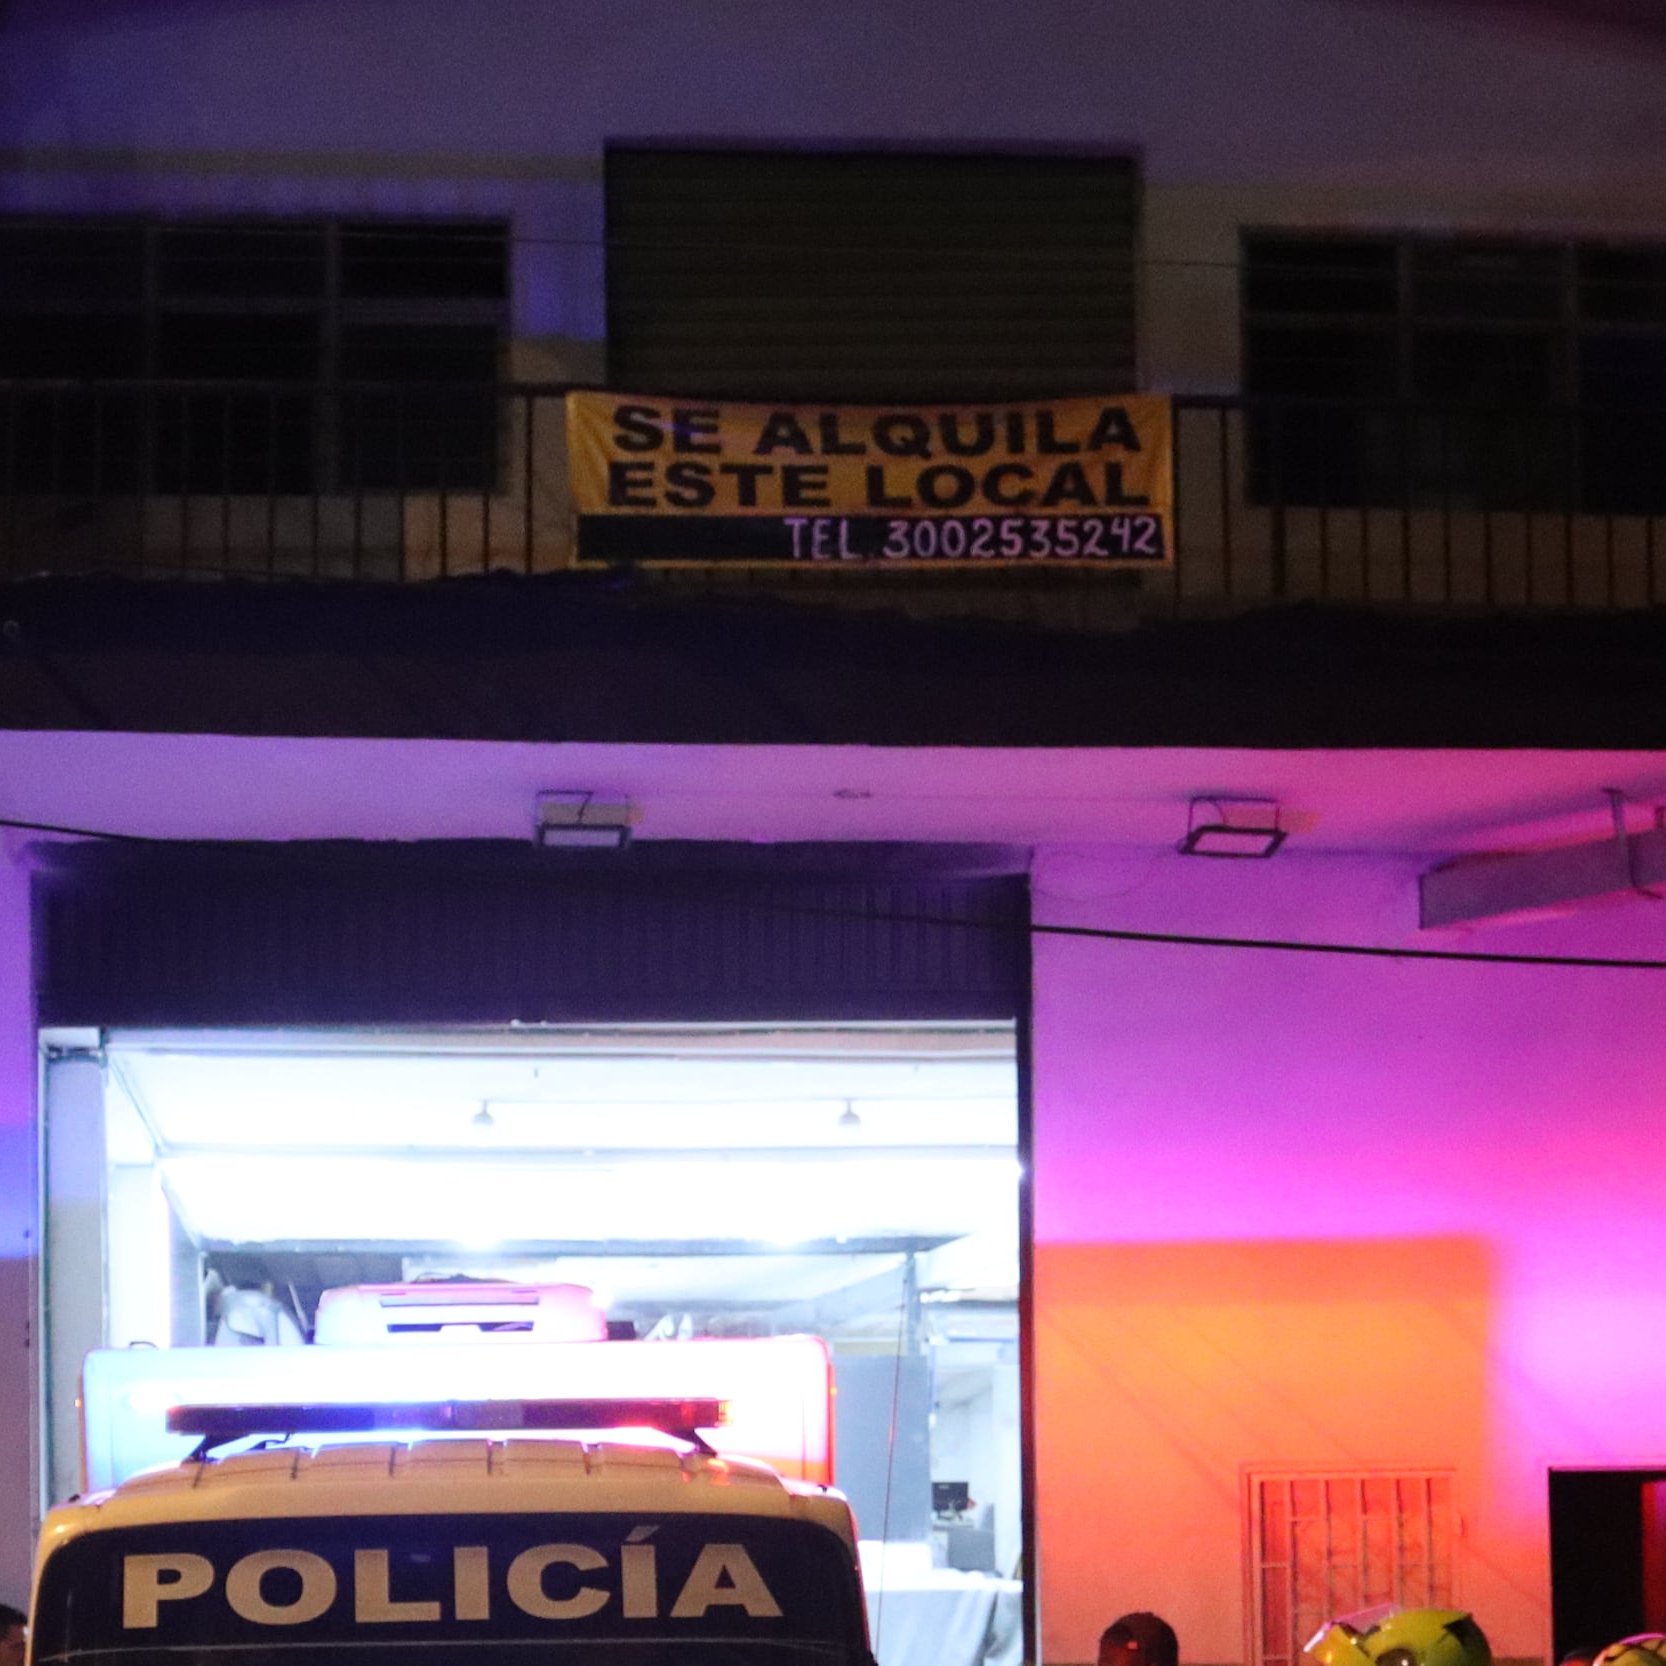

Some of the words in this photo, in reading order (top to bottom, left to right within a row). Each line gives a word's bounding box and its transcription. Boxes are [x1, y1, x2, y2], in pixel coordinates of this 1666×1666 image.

[614, 405, 721, 453] SE
[754, 408, 1141, 459] ALQUILA
[609, 462, 831, 507] ESTE
[866, 463, 1150, 508] LOCAL
[883, 515, 1157, 558] 3002535242
[123, 1526, 783, 1629] POLICÍA
